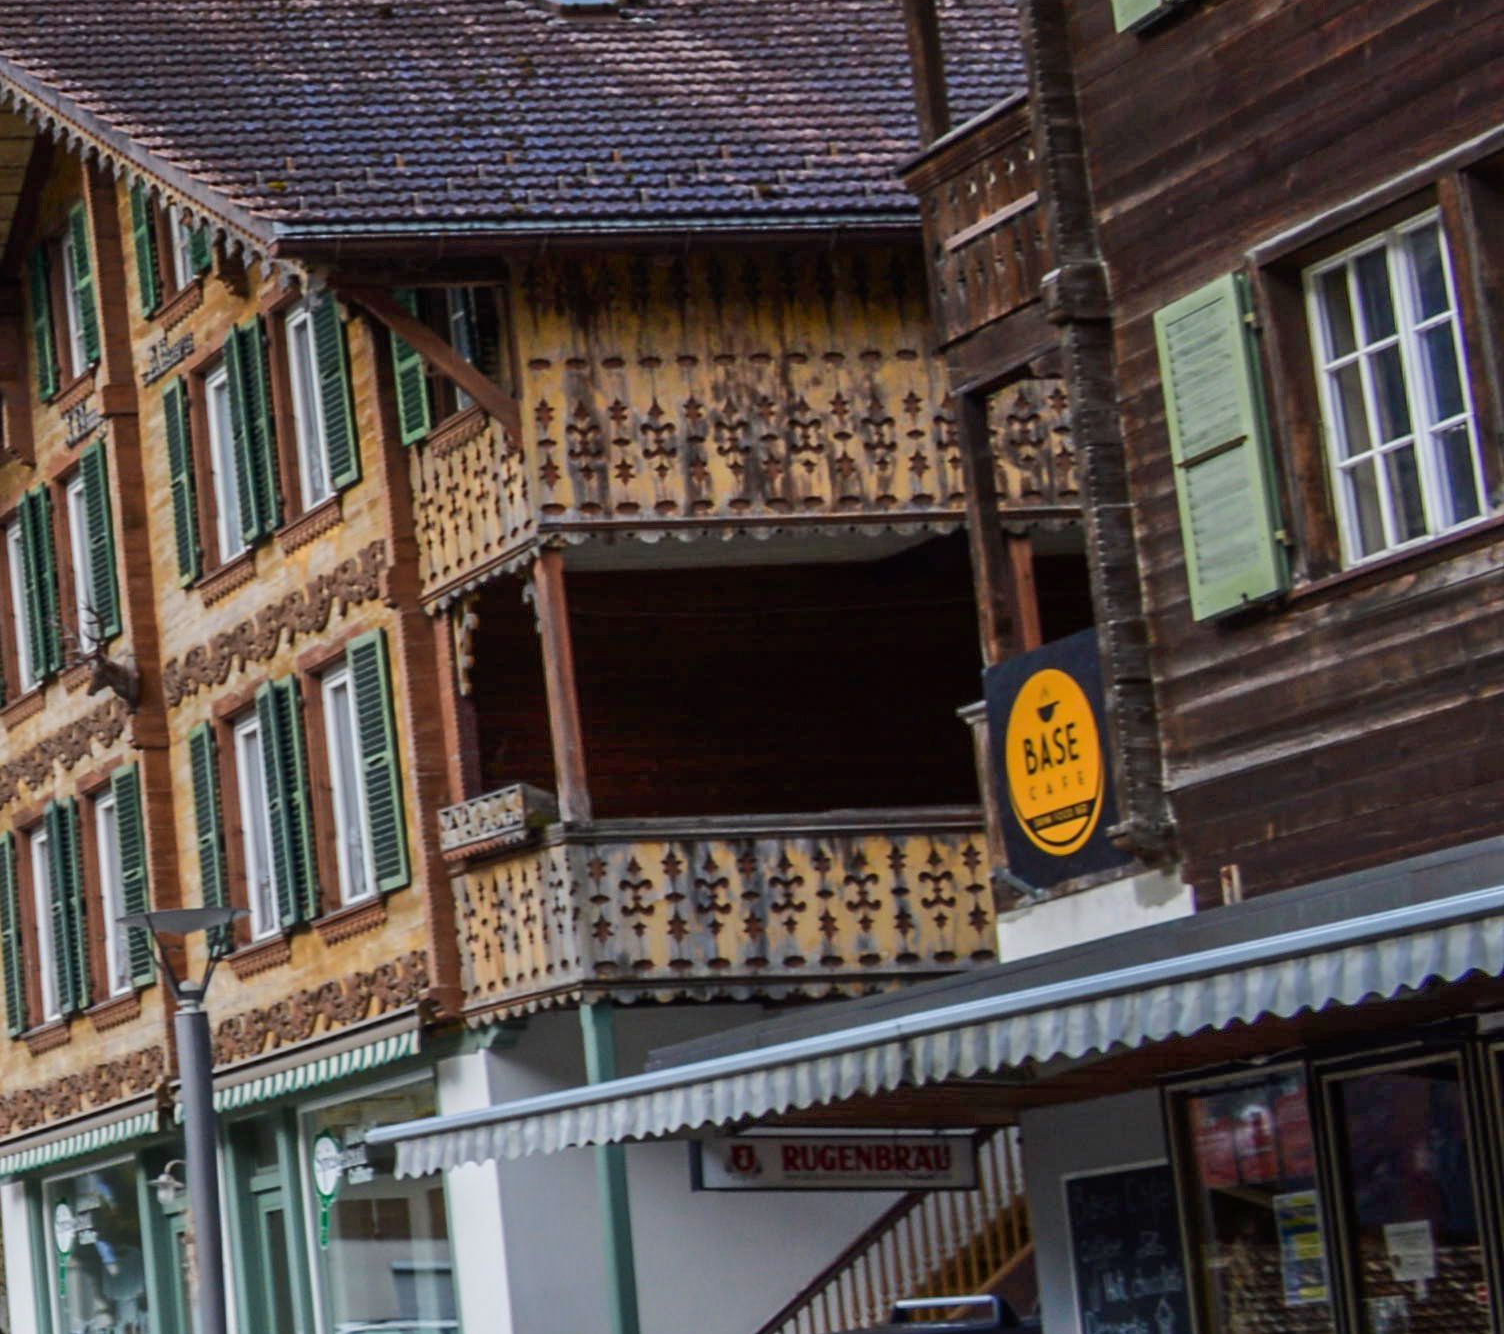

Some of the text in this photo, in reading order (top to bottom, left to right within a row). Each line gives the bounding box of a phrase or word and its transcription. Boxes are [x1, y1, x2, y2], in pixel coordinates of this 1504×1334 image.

[1022, 723, 1080, 776] BASE
[1029, 770, 1086, 801] CAFE
[781, 1142, 952, 1172] RUGENBRÄU
